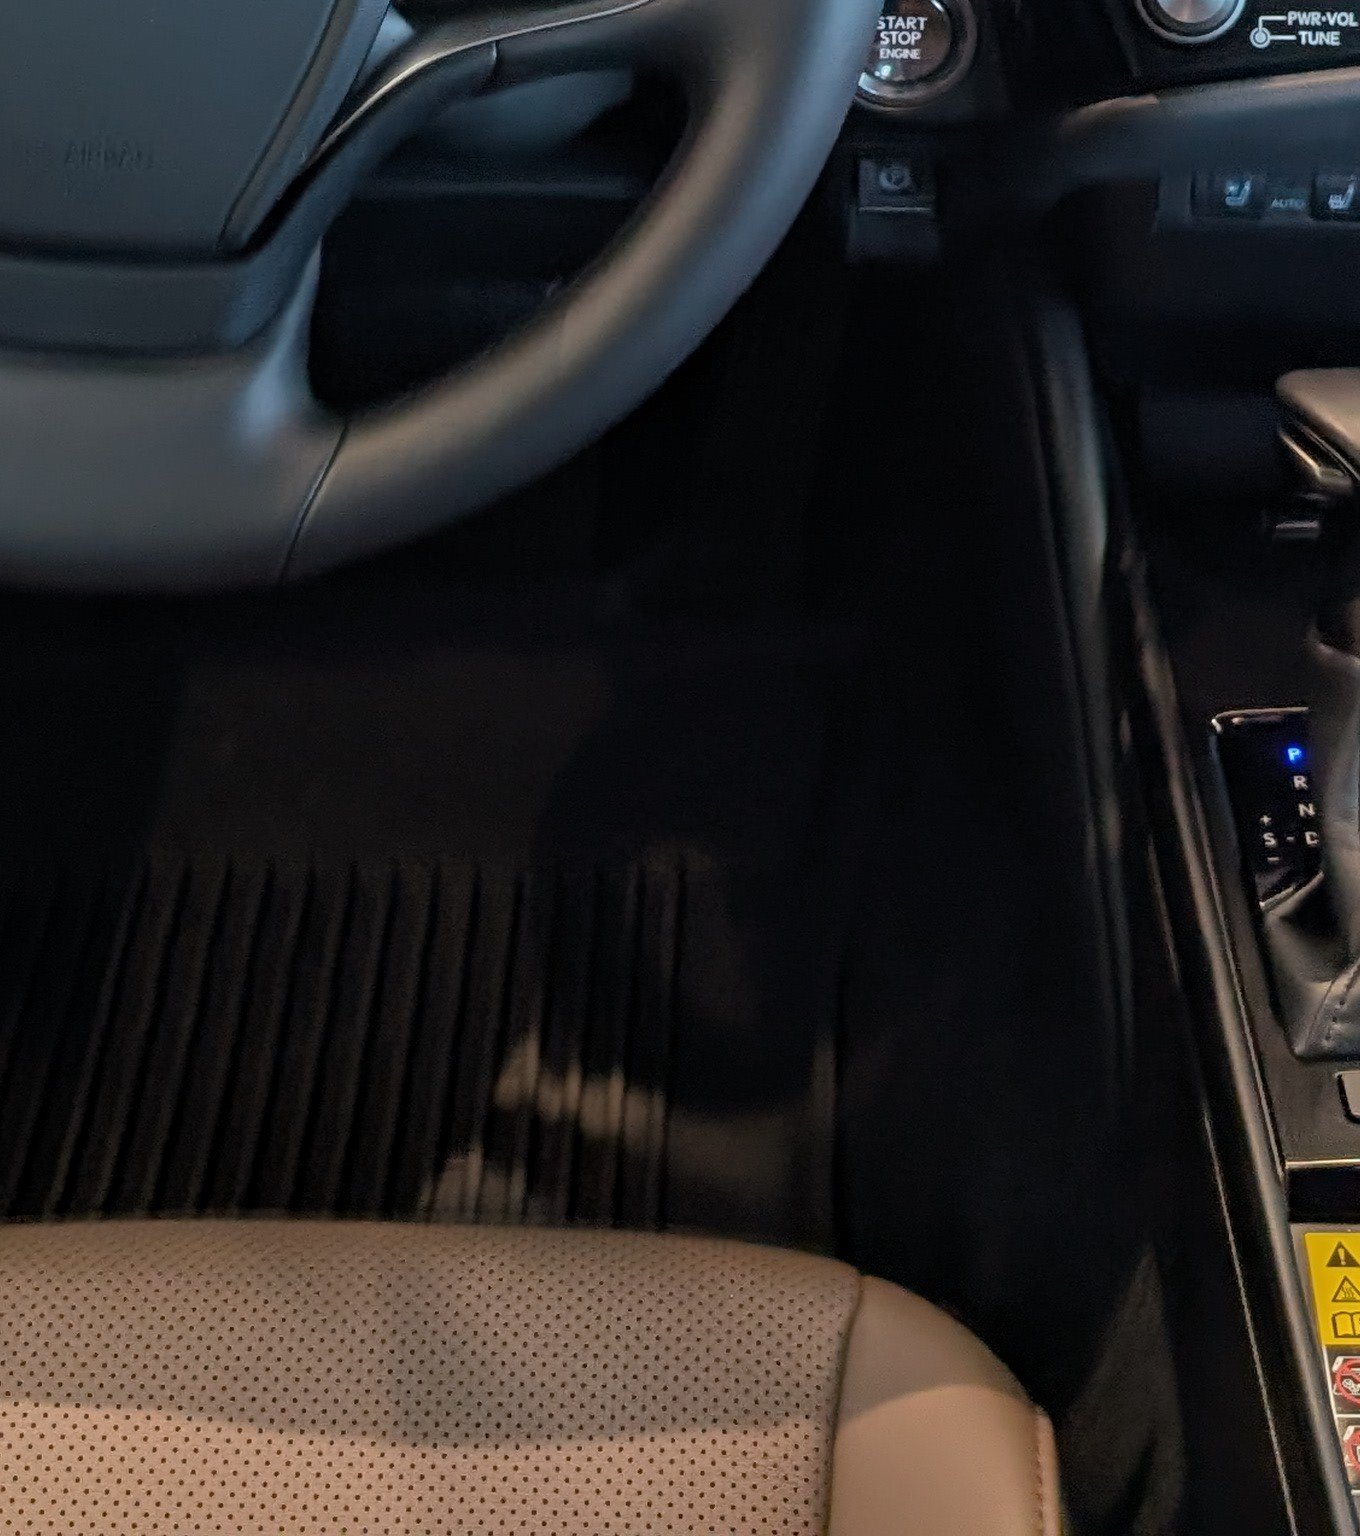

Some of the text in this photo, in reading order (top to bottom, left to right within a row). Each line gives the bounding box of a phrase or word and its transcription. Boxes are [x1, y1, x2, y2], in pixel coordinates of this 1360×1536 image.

[876, 15, 928, 31] START
[879, 30, 922, 46] STOP
[1298, 30, 1341, 47] TUNE
[879, 47, 921, 60] ENGINE
[1287, 747, 1302, 761] P
[1292, 775, 1308, 791] R
[1298, 803, 1316, 818] N
[1262, 832, 1278, 848] S
